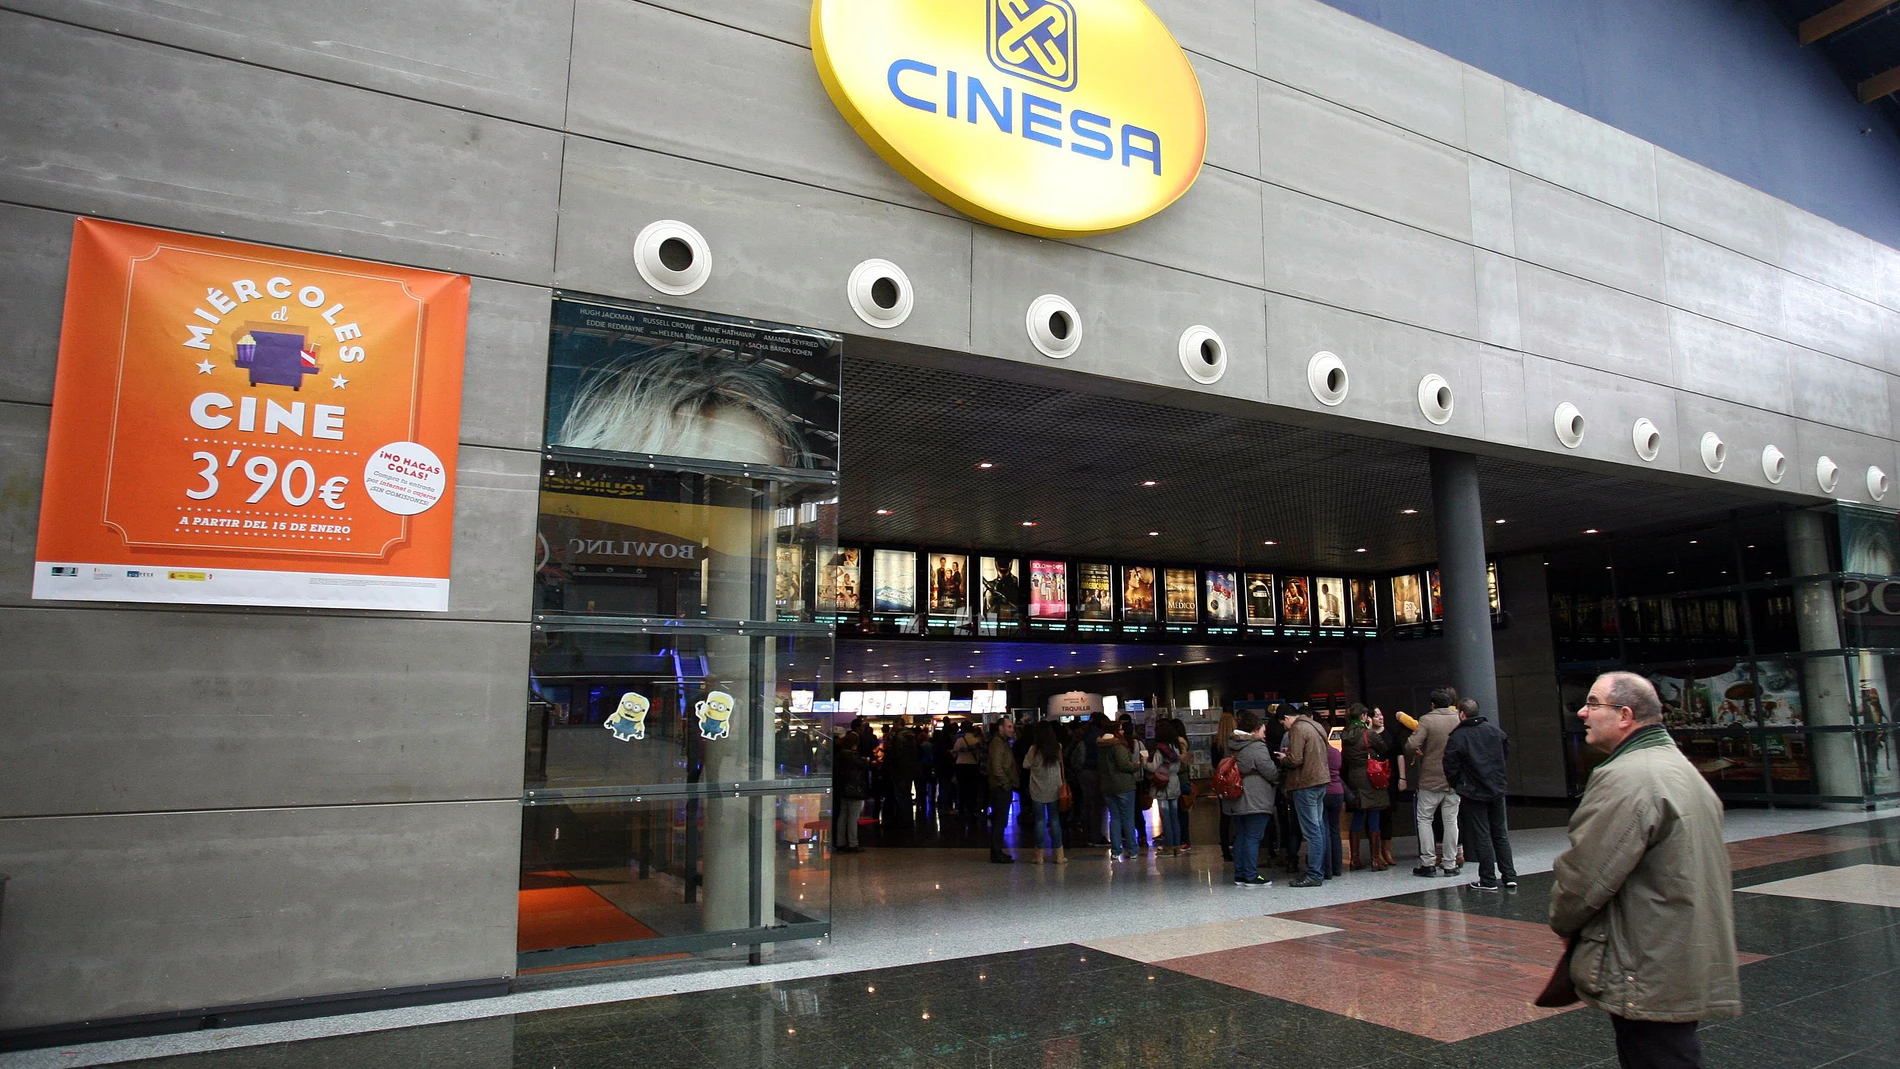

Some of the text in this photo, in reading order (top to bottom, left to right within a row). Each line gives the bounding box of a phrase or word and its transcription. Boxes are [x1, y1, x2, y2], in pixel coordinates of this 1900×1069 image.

[887, 58, 1162, 176] CINESA
[182, 276, 366, 363] MIÉRCOLES
[271, 306, 289, 322] al
[579, 308, 635, 321] HUGH JACKMAN
[586, 319, 606, 328] EDDIE
[607, 322, 644, 333] REDMAYNE
[643, 317, 695, 330] RUSSELL CROWE
[658, 330, 684, 339] HELENA
[685, 333, 715, 343] BONHAM
[716, 337, 740, 347] CARTER
[703, 326, 756, 339] ANNE HATHAWAY
[748, 342, 813, 357] SACHA BARON COHEN
[763, 335, 819, 348] AMANDA SEYFRIED
[190, 392, 346, 440] CINE
[387, 463, 429, 480] COLAS!
[373, 470, 400, 483] Compra
[408, 481, 436, 493] entrada
[379, 480, 407, 492] internet
[412, 489, 437, 501] cajeros
[179, 516, 351, 535] A PARTIR DEL 15 DE ENERO
